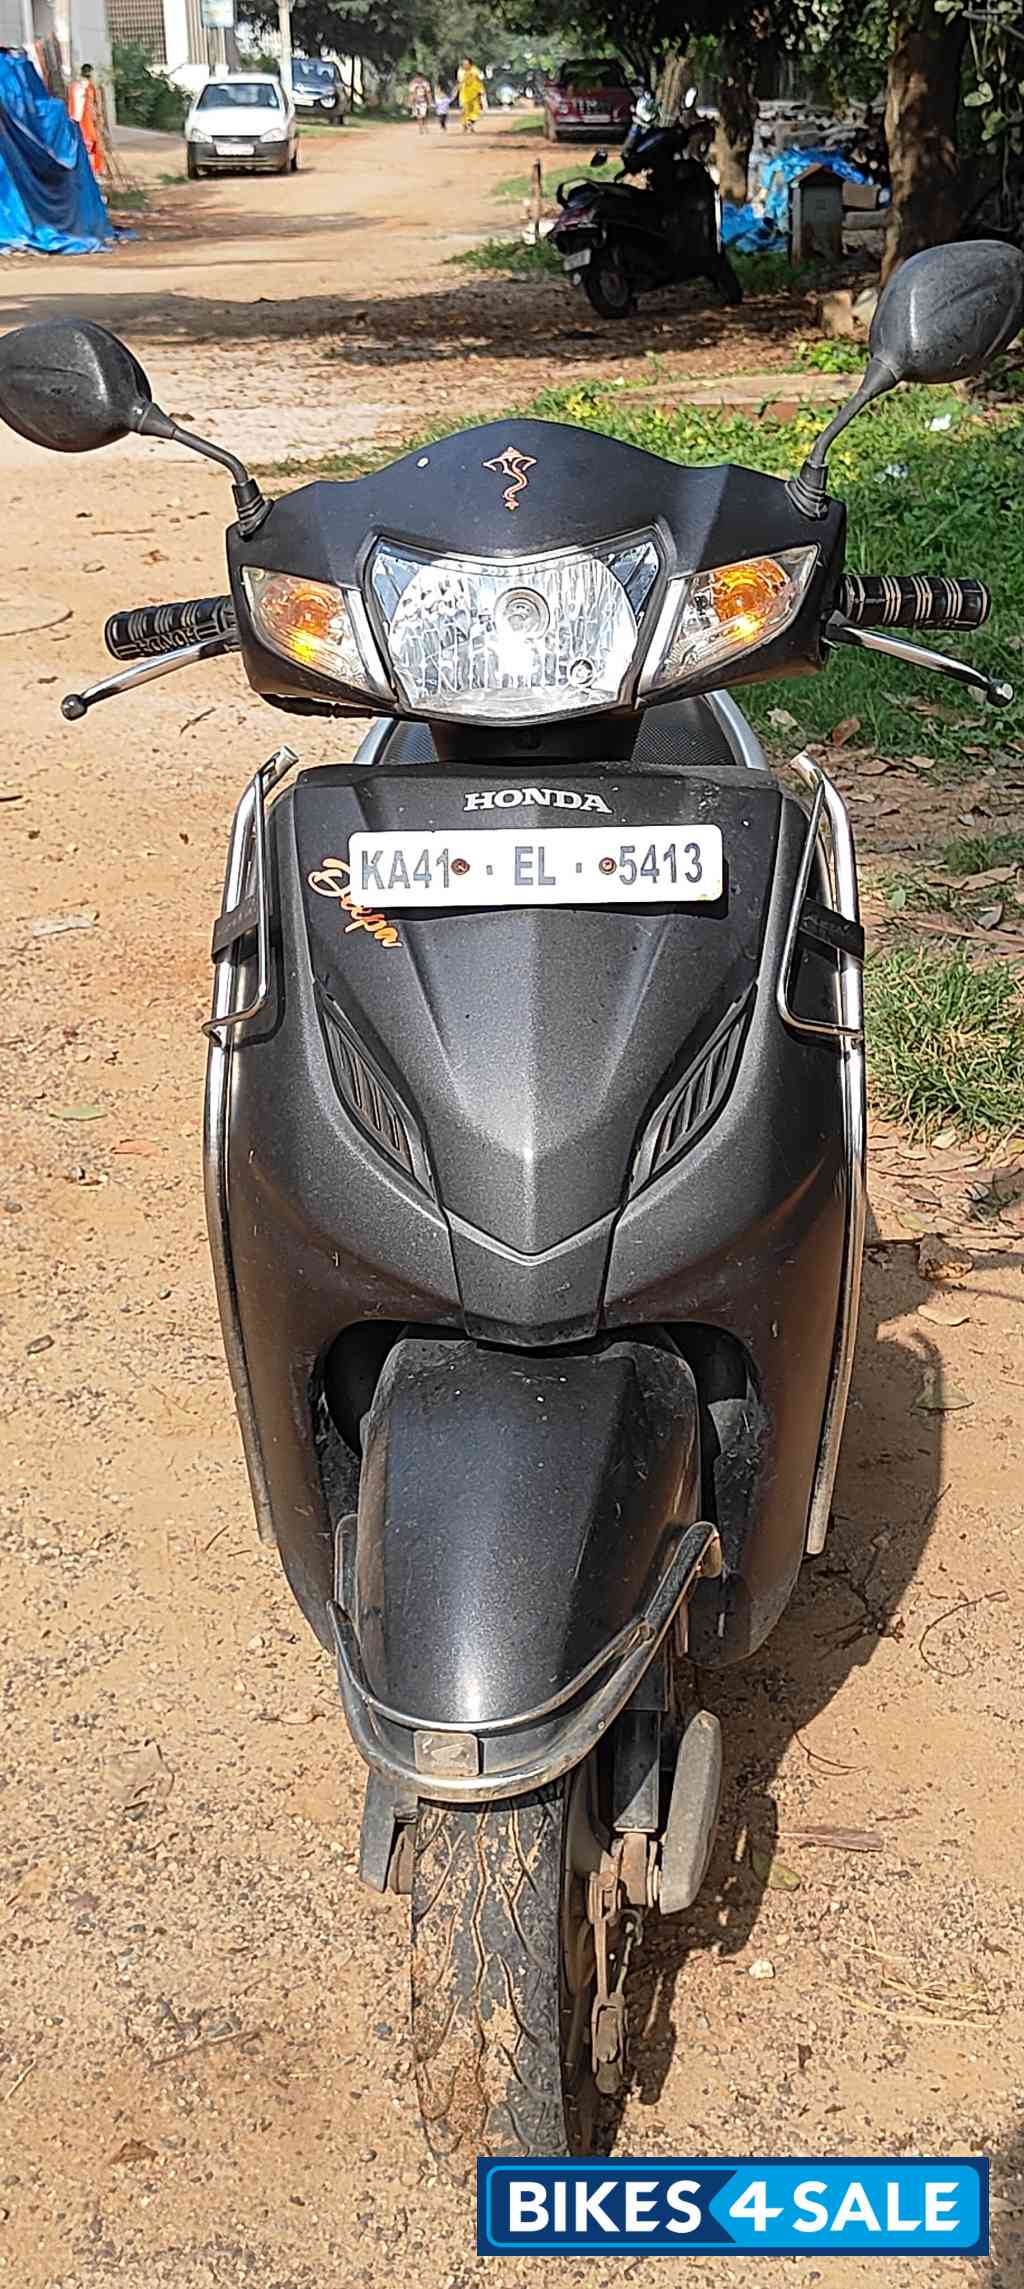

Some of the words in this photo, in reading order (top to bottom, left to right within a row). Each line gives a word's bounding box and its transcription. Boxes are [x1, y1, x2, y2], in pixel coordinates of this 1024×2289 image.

[463, 787, 613, 814] HONDA
[361, 848, 450, 890] KA41
[514, 846, 557, 886] EL
[618, 842, 703, 886] 5413
